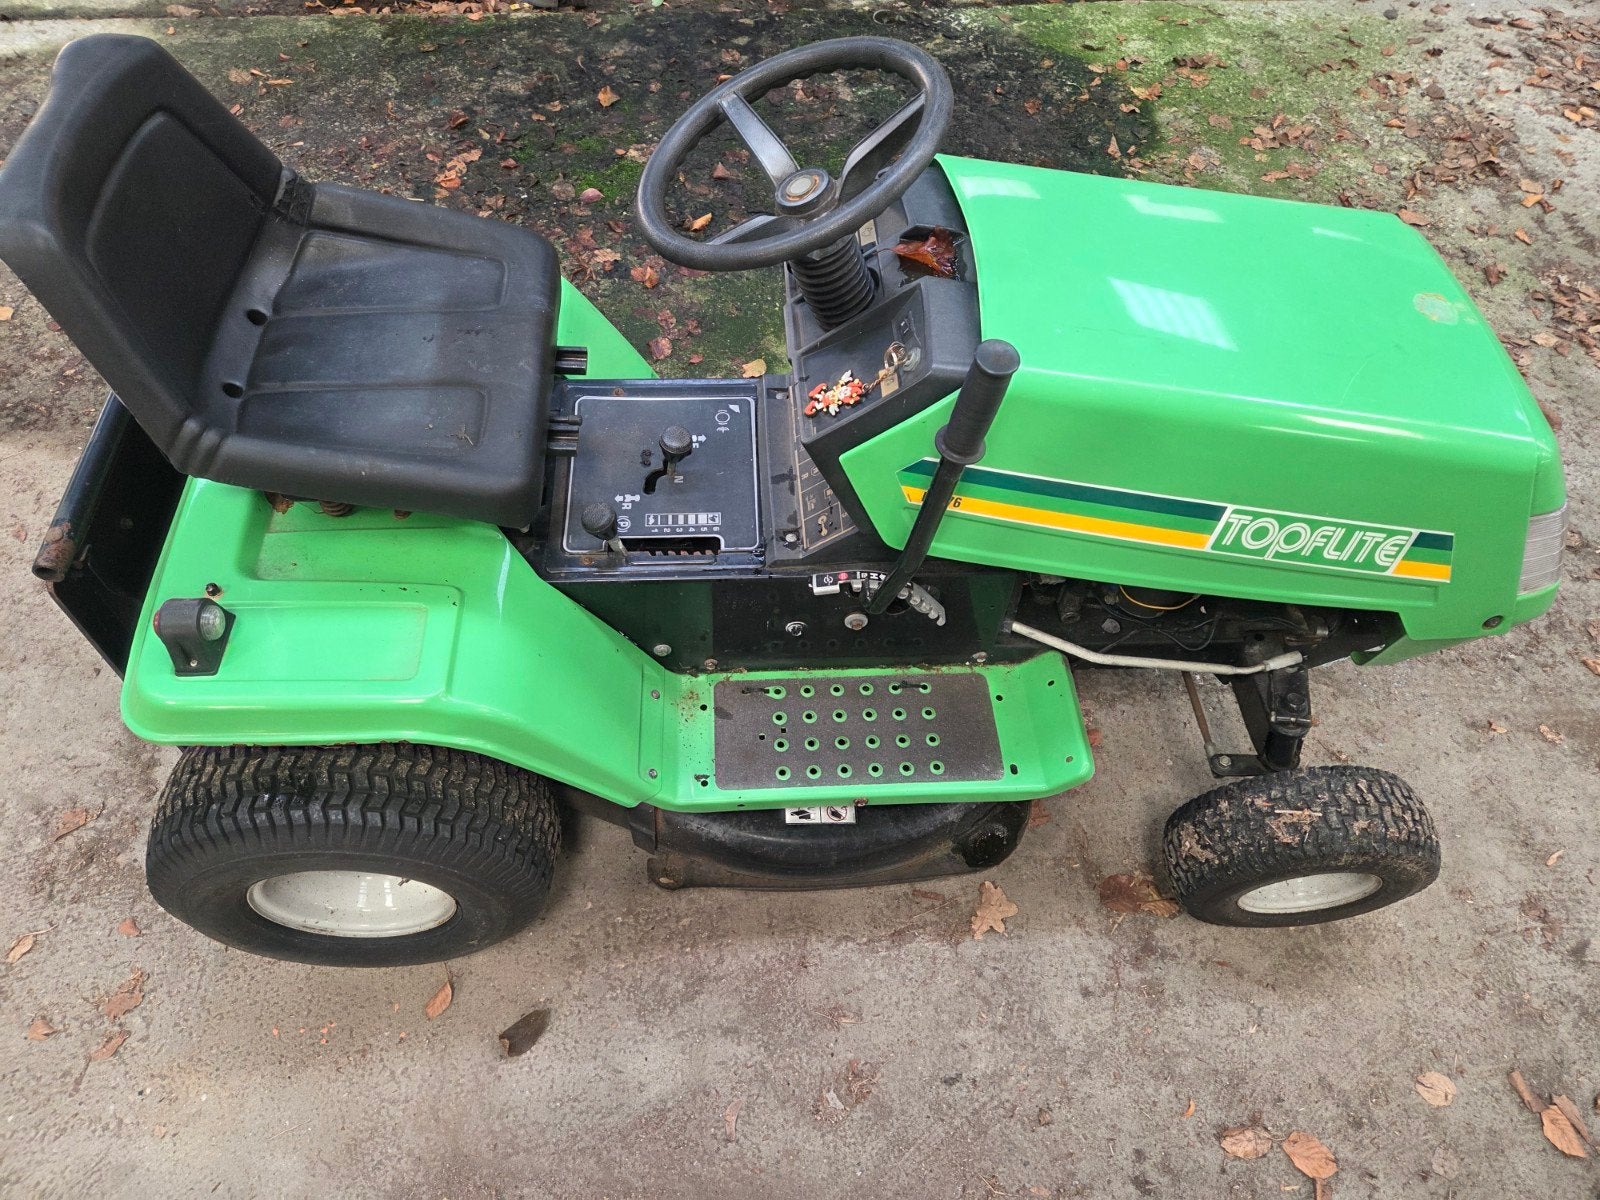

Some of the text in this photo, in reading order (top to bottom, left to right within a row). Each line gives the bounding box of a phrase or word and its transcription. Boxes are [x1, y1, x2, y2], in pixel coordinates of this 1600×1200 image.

[674, 475, 684, 483] N
[621, 502, 632, 510] R
[1221, 512, 1410, 567] TOPFLITE
